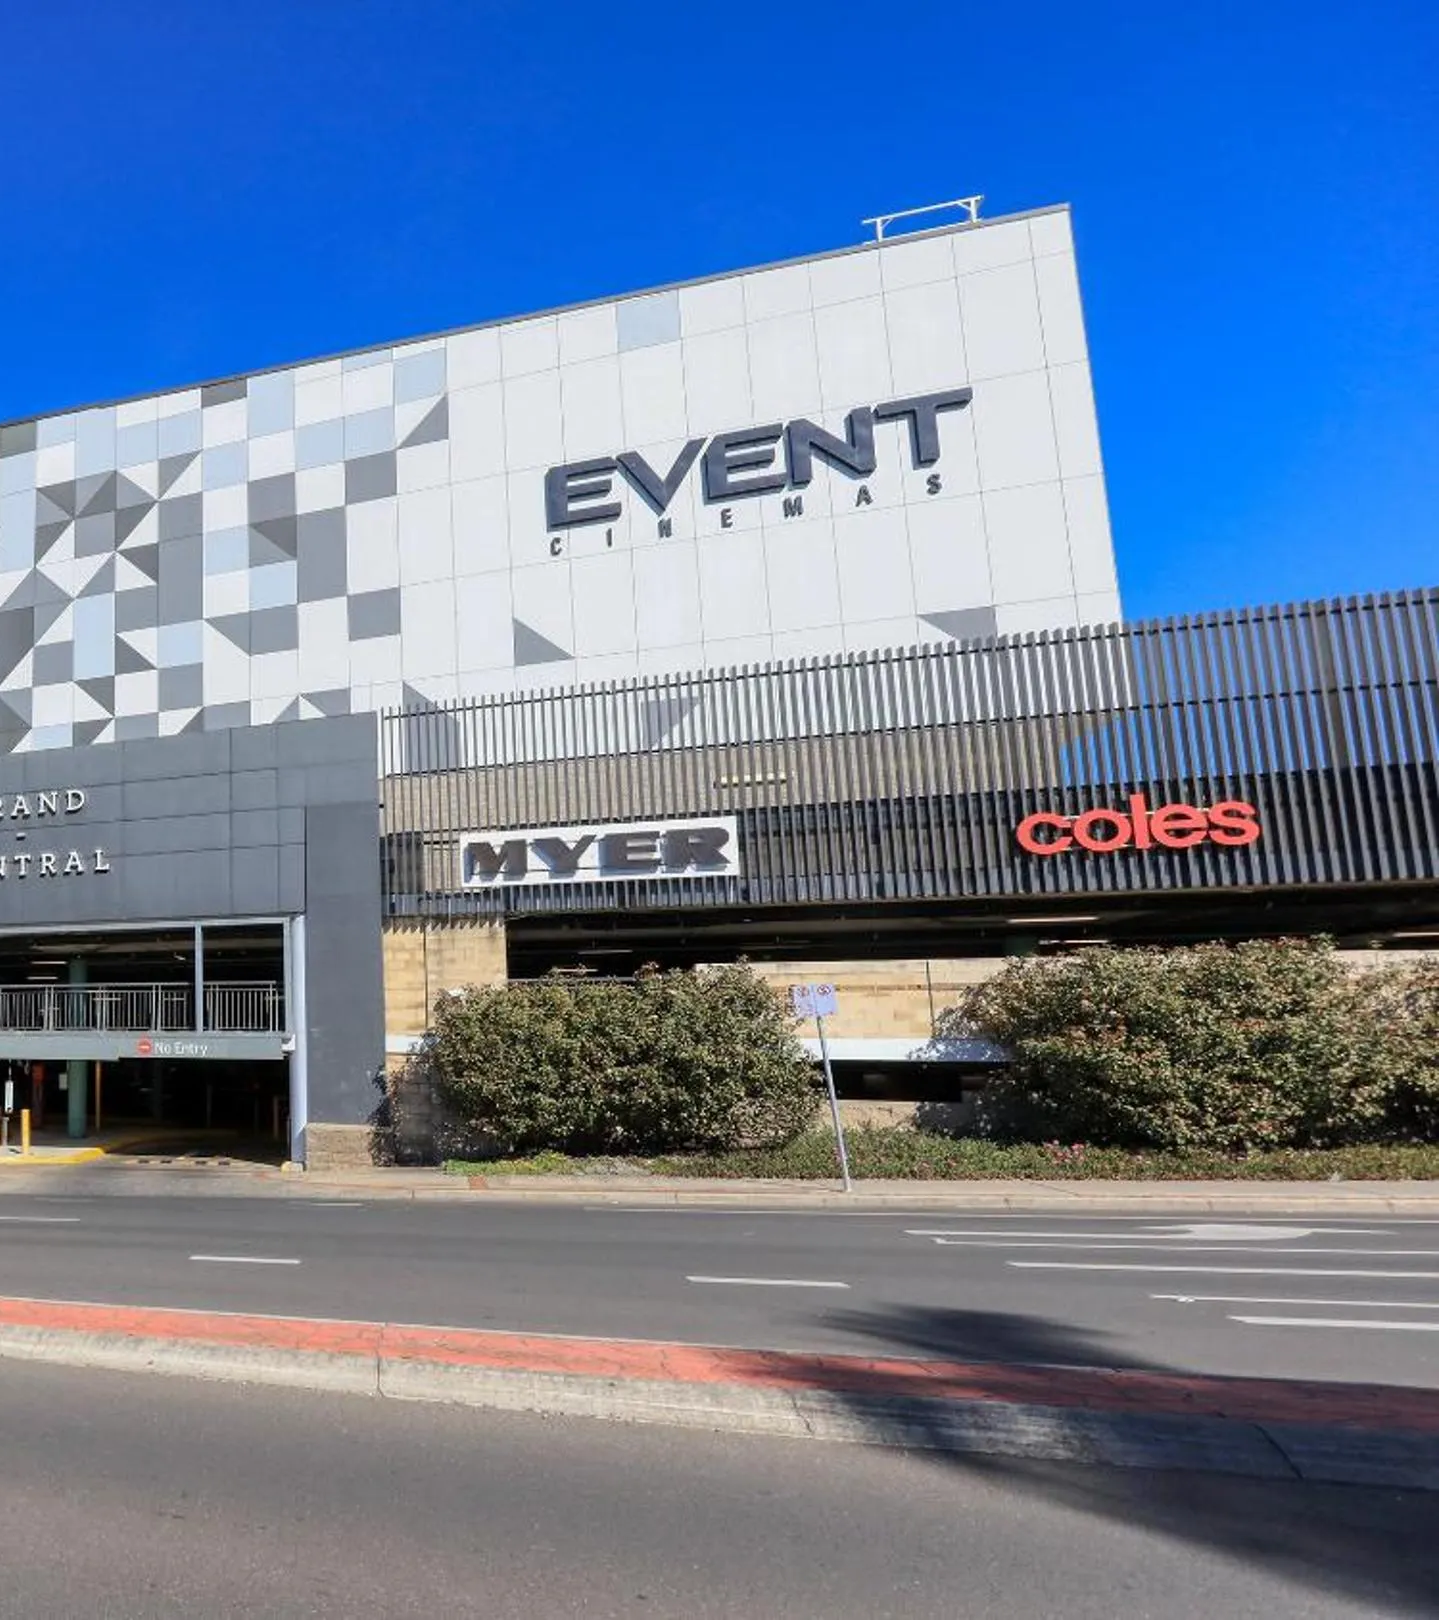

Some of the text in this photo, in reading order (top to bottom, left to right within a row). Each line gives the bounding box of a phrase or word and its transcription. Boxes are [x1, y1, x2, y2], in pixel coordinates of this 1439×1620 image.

[545, 387, 973, 531] EVENT
[549, 472, 943, 557] CINEMAS
[464, 826, 732, 883] MYER
[1016, 793, 1262, 855] coles
[154, 1041, 208, 1057] No Entry
